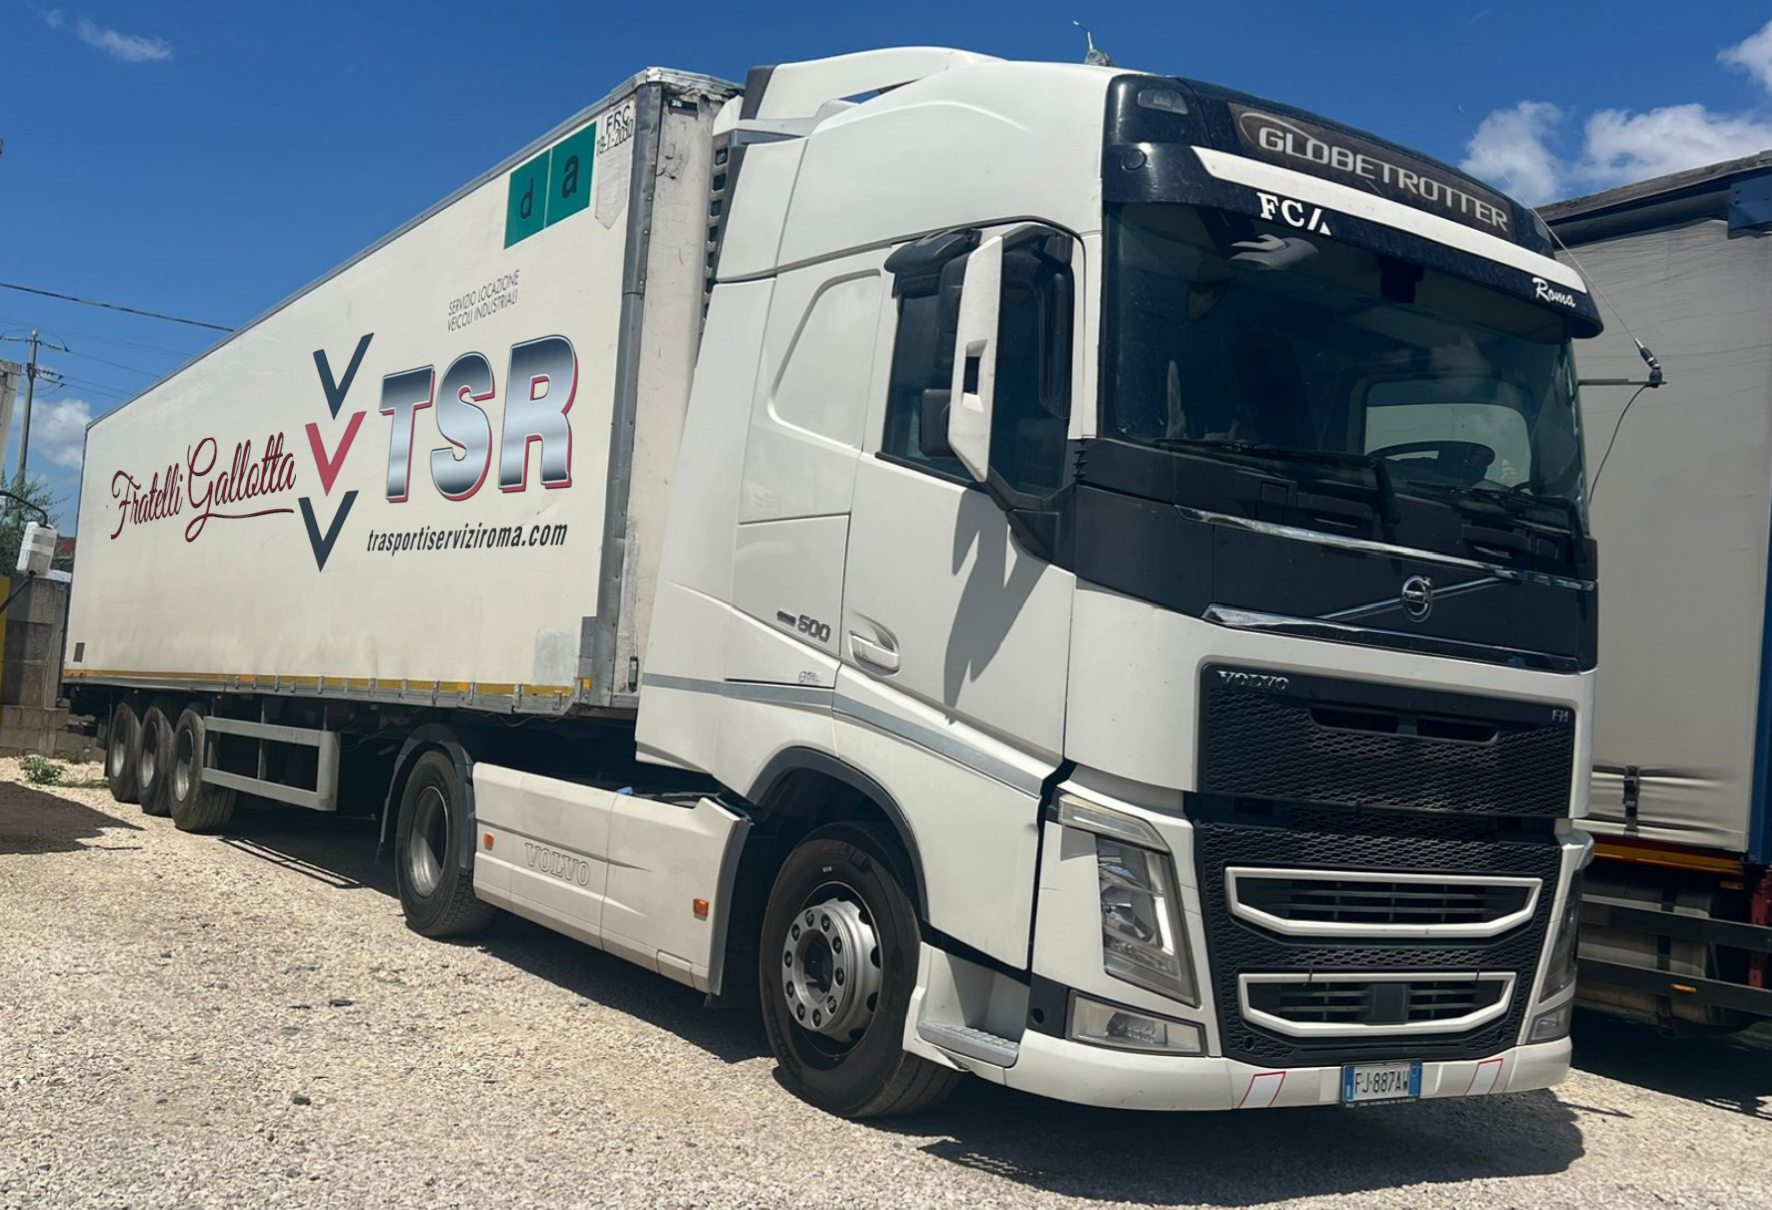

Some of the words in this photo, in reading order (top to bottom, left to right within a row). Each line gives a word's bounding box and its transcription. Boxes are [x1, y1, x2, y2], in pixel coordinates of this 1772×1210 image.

[606, 105, 630, 135] FRC
[1258, 126, 1509, 232] GLOBETROTTER
[478, 269, 519, 303] LOCAZIONE
[1532, 277, 1576, 308] Roma
[379, 334, 578, 503] TSR
[110, 463, 183, 540] Fratelli
[185, 432, 296, 542] Gallotta
[367, 521, 568, 556] trasportiserviziroma.com
[797, 614, 831, 643] 500
[1216, 670, 1290, 691] VOLVO
[525, 842, 591, 887] VOLVO
